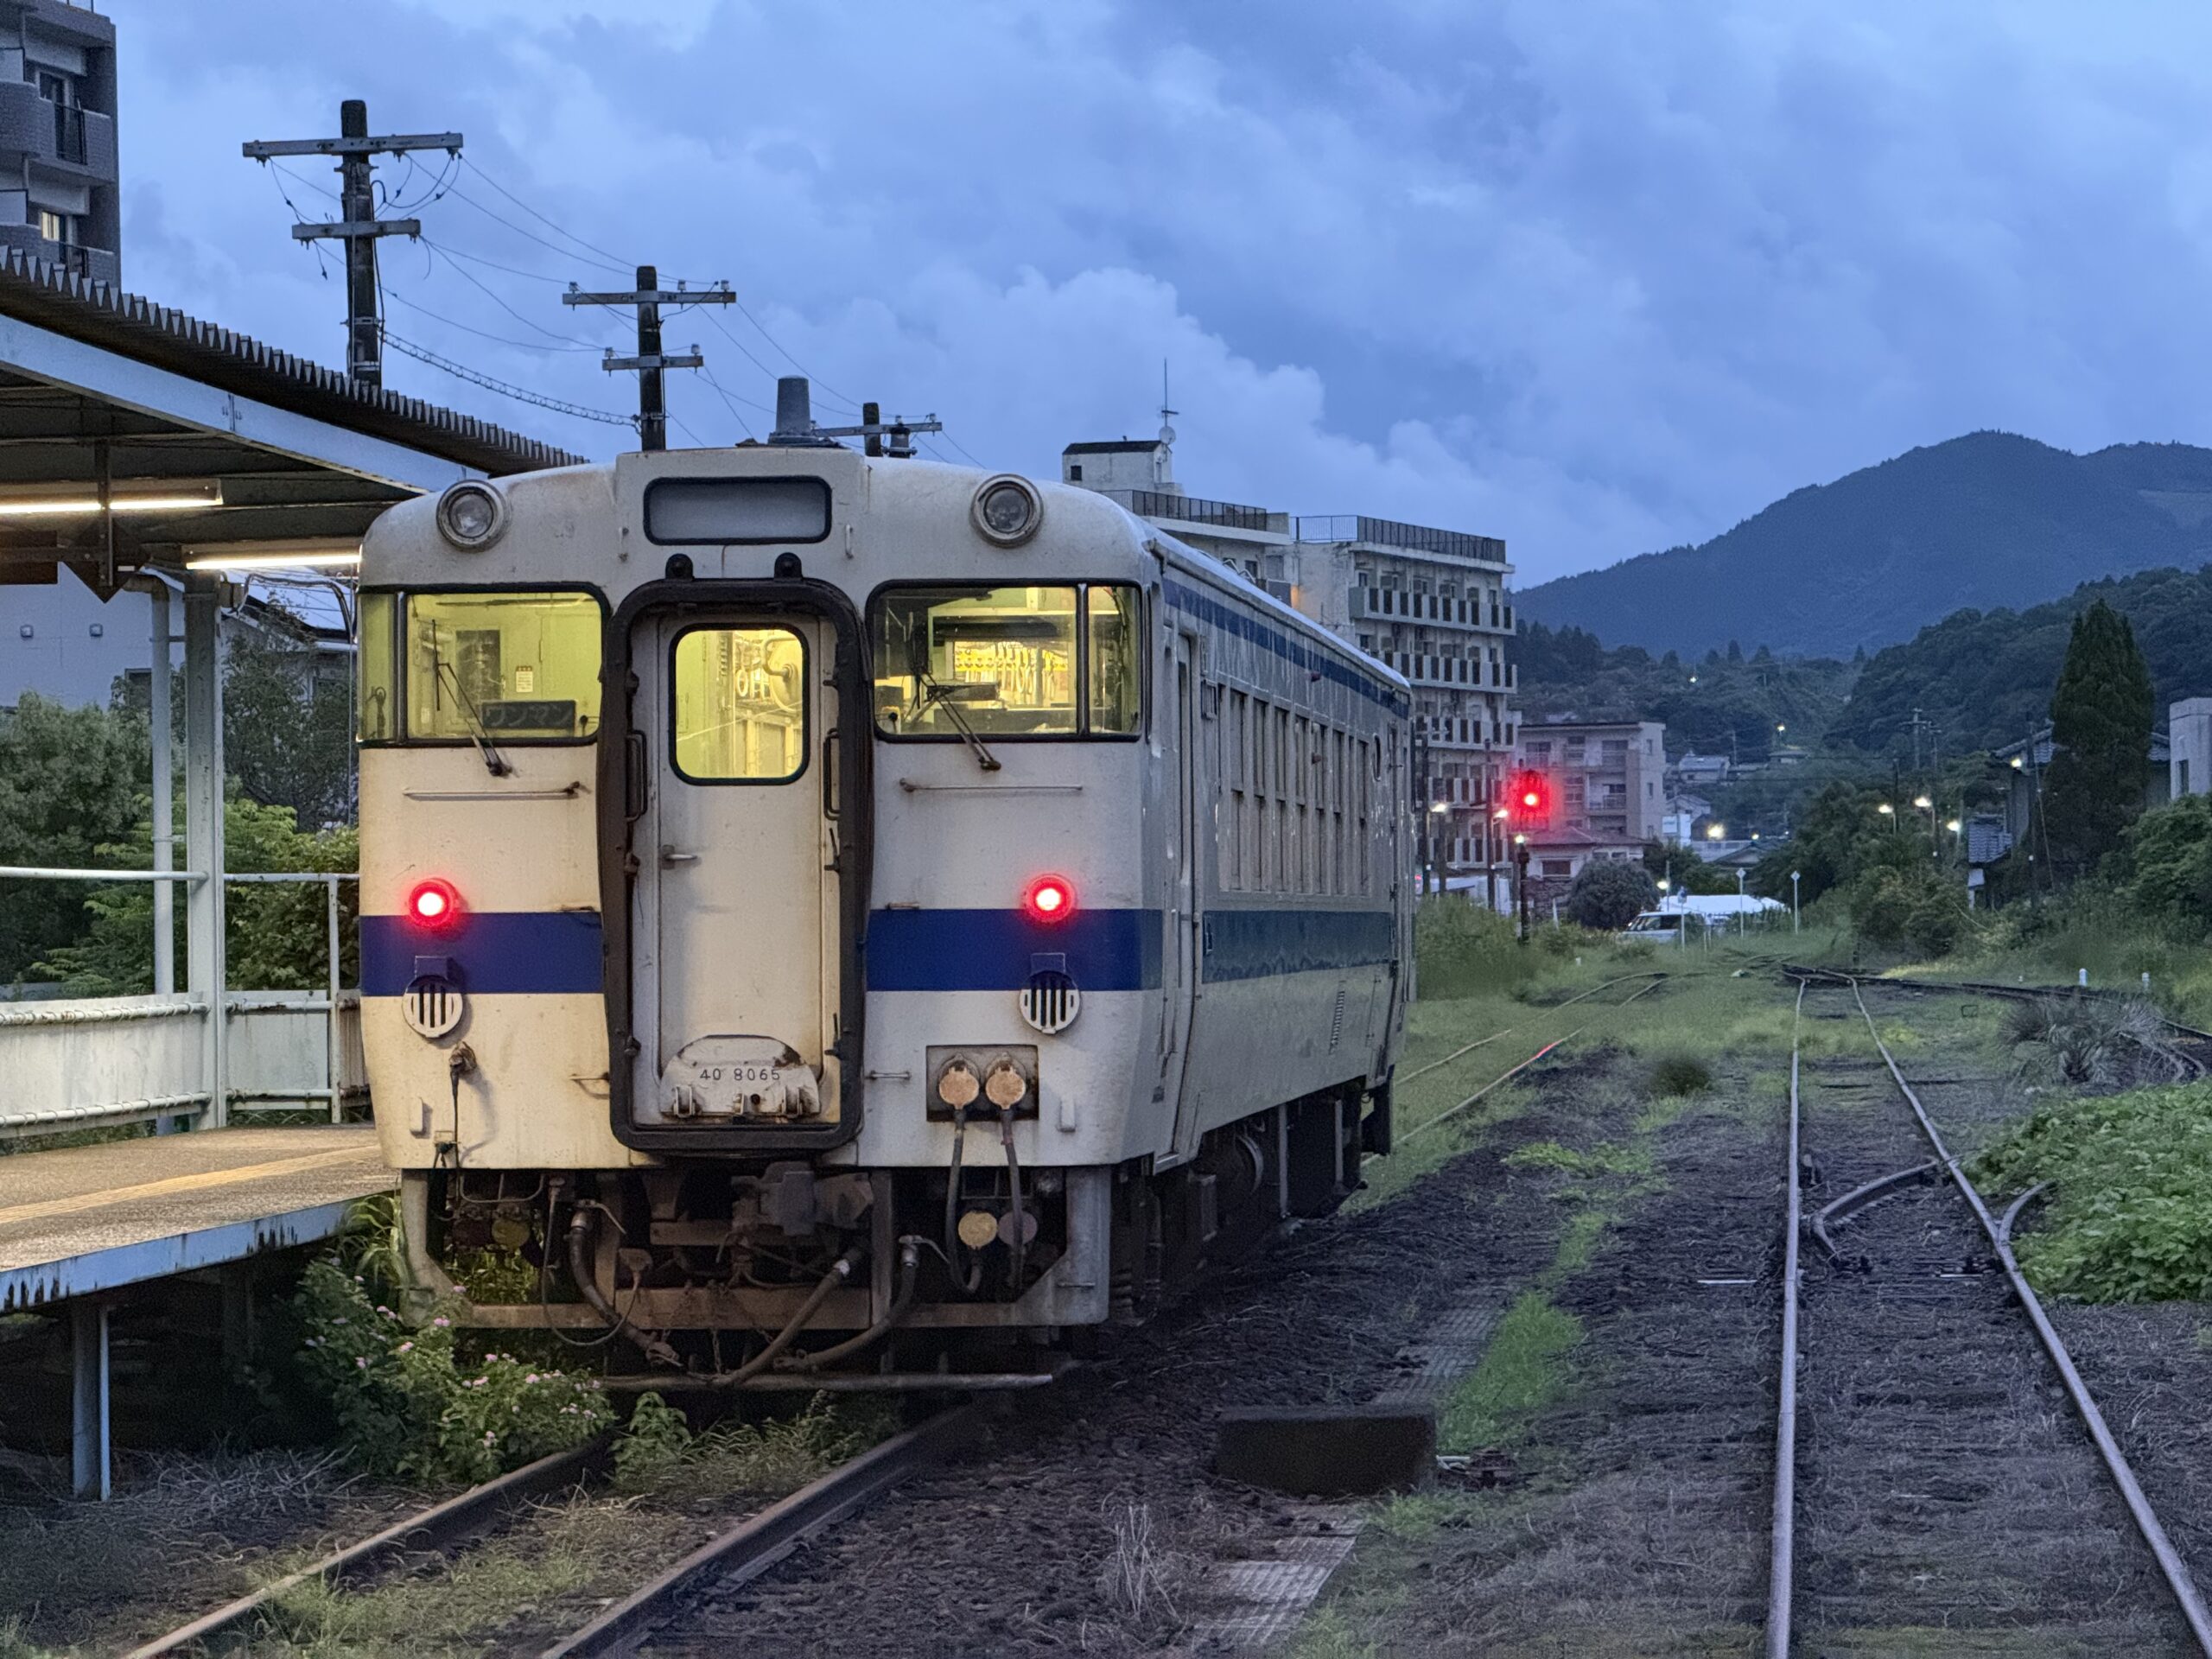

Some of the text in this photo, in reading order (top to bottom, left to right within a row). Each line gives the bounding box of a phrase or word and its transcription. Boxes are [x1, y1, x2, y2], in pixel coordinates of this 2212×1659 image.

[485, 704, 573, 728] ワンマン
[699, 1067, 780, 1081] 40 8065
